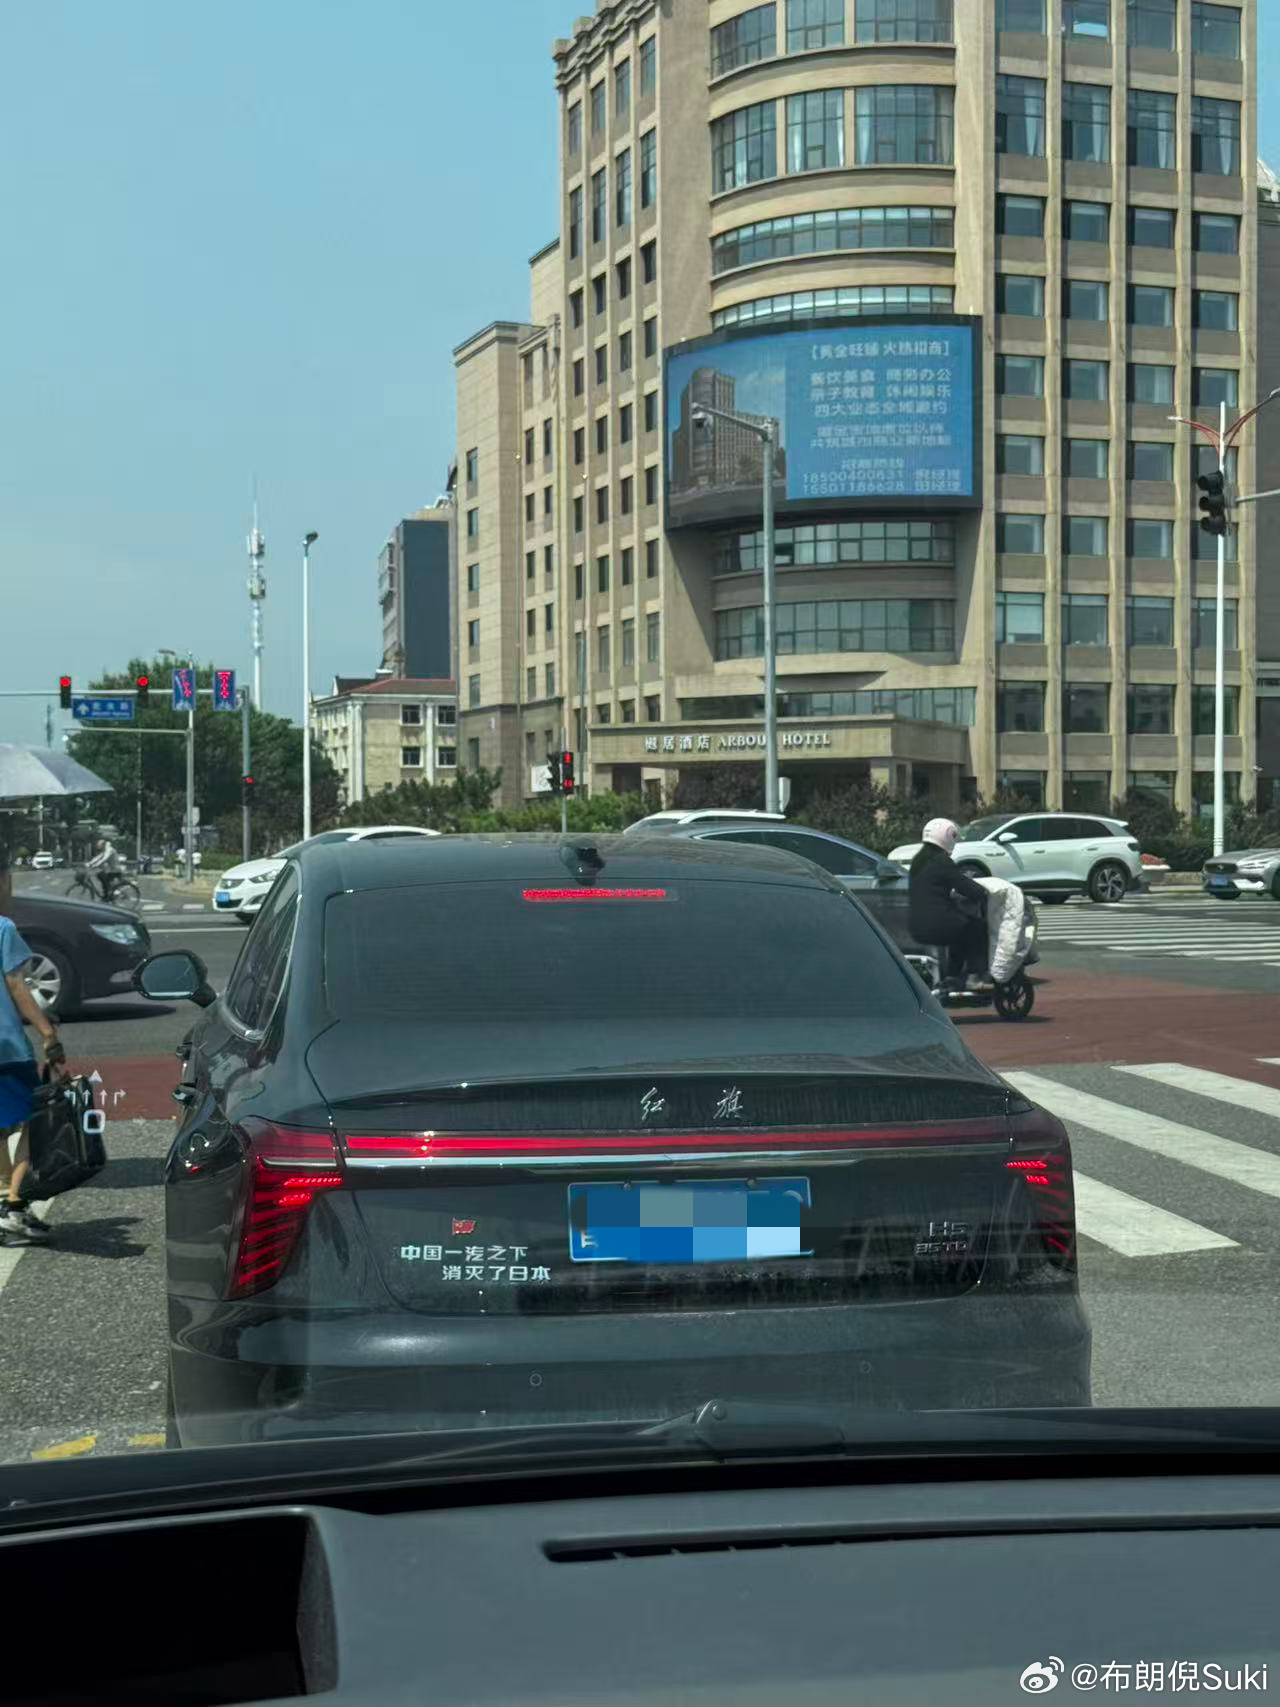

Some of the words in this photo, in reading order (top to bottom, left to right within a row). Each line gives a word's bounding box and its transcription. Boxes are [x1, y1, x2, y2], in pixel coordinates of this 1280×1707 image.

[886, 368, 952, 382] 商务办公
[810, 385, 875, 402] 亲子教育
[886, 384, 952, 399] 休闲娱乐
[718, 734, 767, 748] ARBOU
[782, 733, 831, 746] HOTEL
[400, 1245, 529, 1262] 中国一汽之下
[441, 1265, 551, 1281] 消灭了日本
